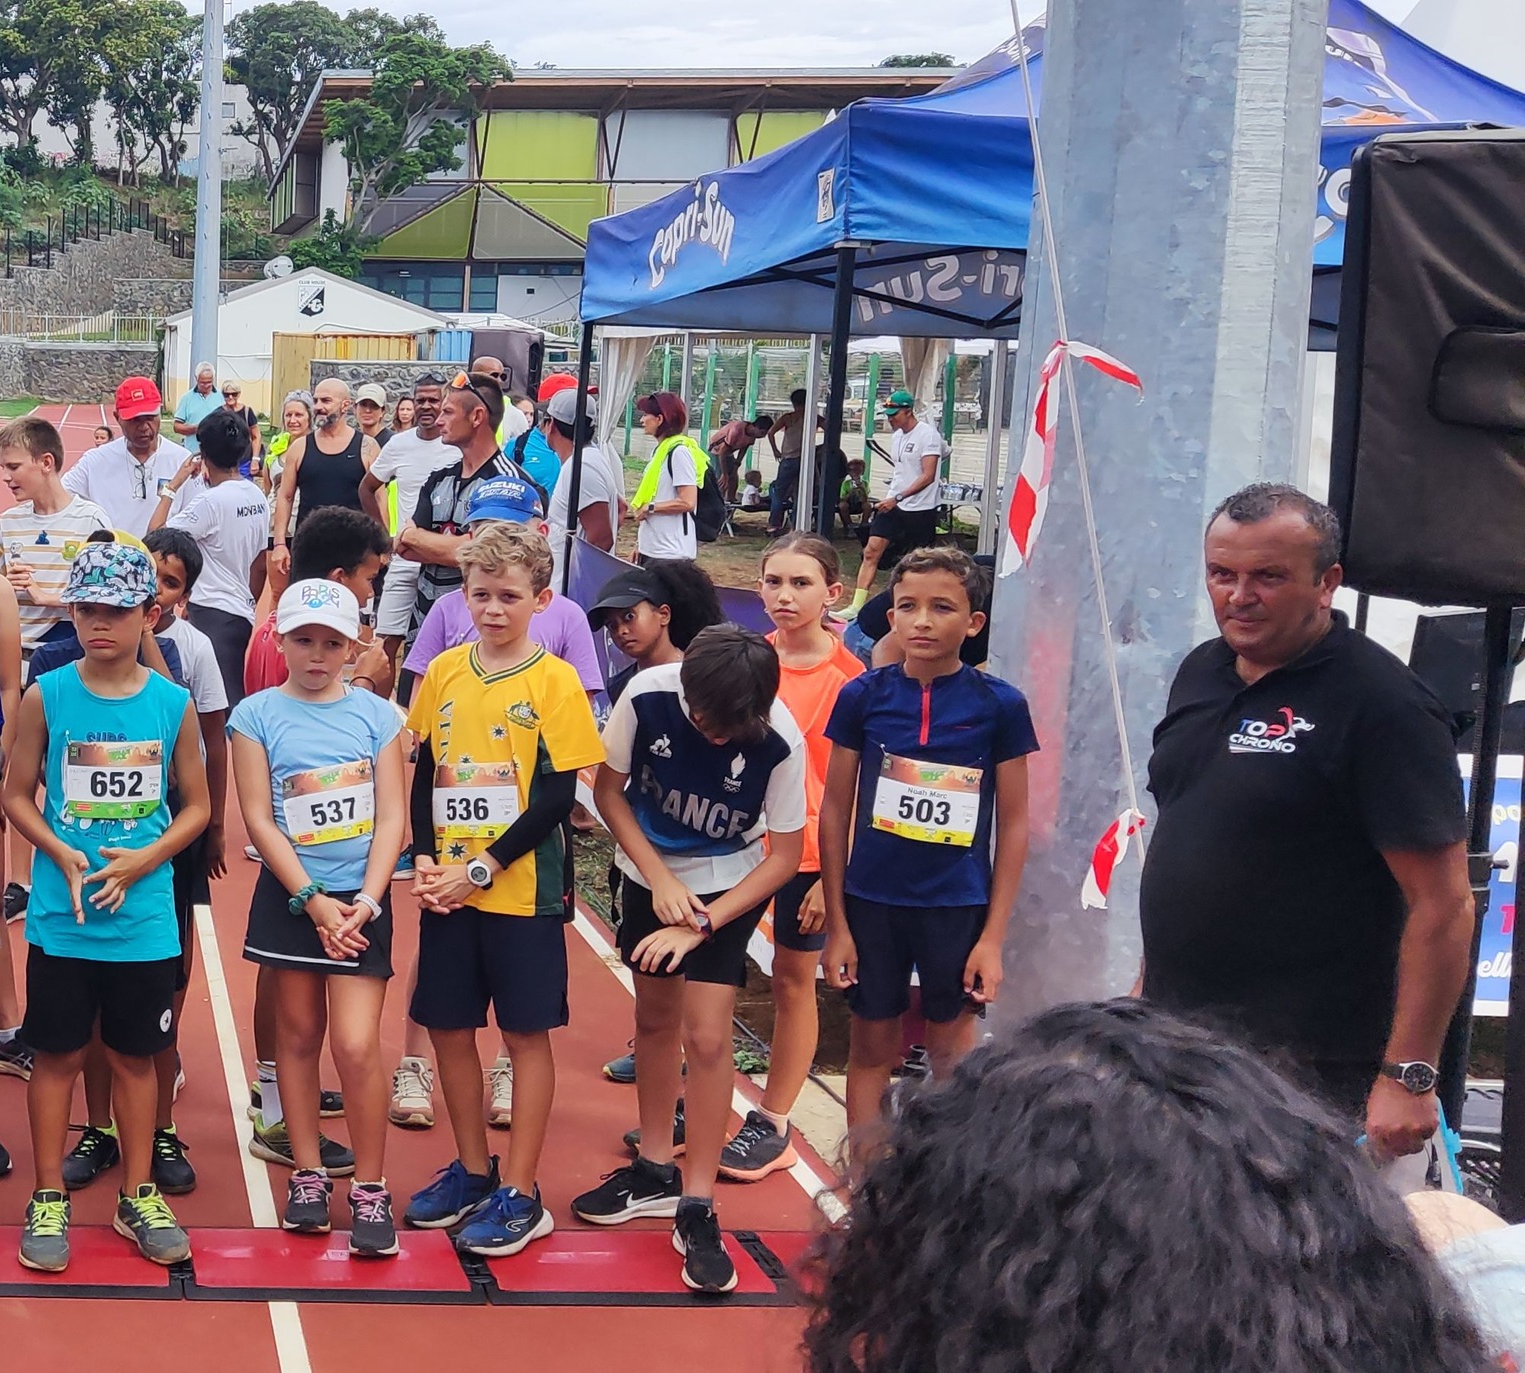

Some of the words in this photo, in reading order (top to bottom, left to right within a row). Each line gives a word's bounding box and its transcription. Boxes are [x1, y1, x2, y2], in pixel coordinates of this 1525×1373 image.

[649, 180, 734, 289] Capri-Sun
[478, 481, 525, 493] SUZUKI
[1239, 719, 1286, 737] TOP
[1229, 733, 1296, 753] CHRONO
[90, 771, 143, 797] 652
[907, 787, 928, 797] Noah
[929, 790, 948, 799] Marc
[310, 797, 355, 826] 537
[446, 798, 489, 821] 536
[898, 795, 951, 825] 503
